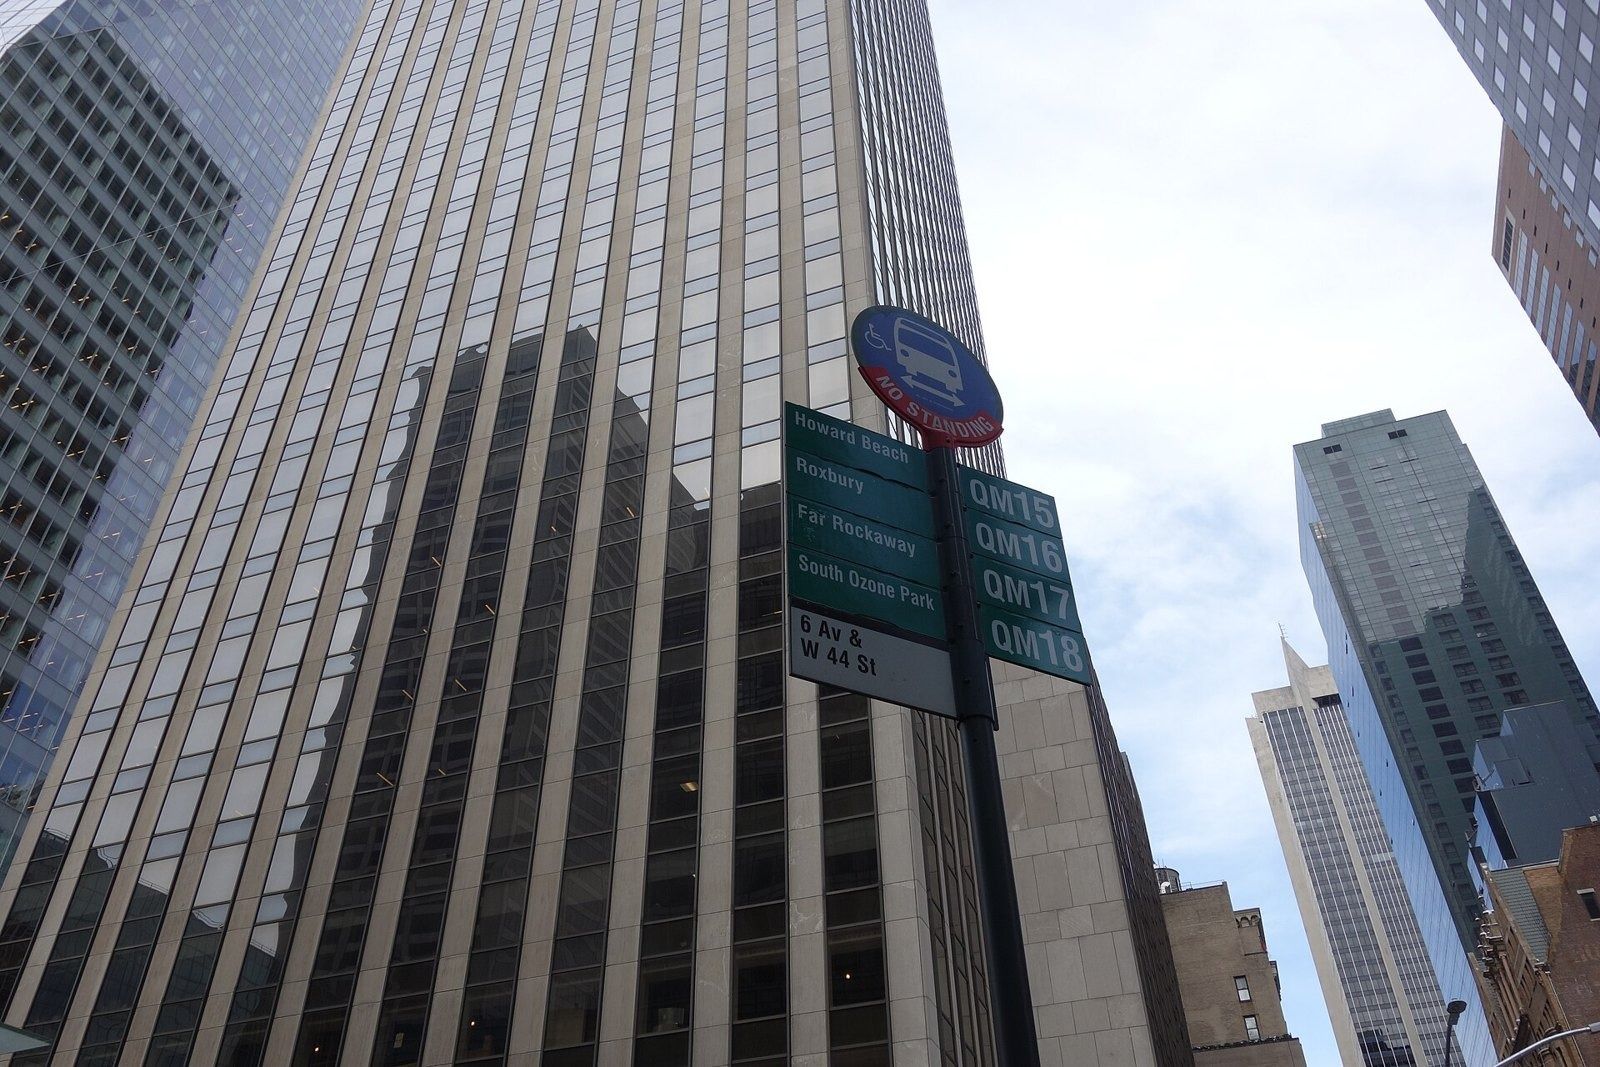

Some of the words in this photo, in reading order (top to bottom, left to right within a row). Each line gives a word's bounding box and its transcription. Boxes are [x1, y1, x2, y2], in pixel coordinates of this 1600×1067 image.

[876, 375, 903, 400] NO
[906, 402, 994, 438] STANDING
[795, 411, 856, 445] Howard
[862, 434, 909, 464] Beach
[796, 457, 864, 494] Roxbury
[969, 478, 1054, 529] QM15
[798, 503, 826, 526] Far
[832, 514, 916, 557] Rockaway
[975, 522, 1063, 573] QM16
[799, 554, 844, 583] South
[849, 570, 895, 598] Ozone
[900, 585, 935, 611] Park
[983, 569, 1070, 620] QM17
[800, 614, 811, 633] 6
[818, 620, 841, 641] Av
[849, 629, 862, 648] &
[991, 619, 1083, 673] QM18
[800, 638, 819, 659] W
[827, 647, 850, 669] 44
[857, 654, 877, 676] St
